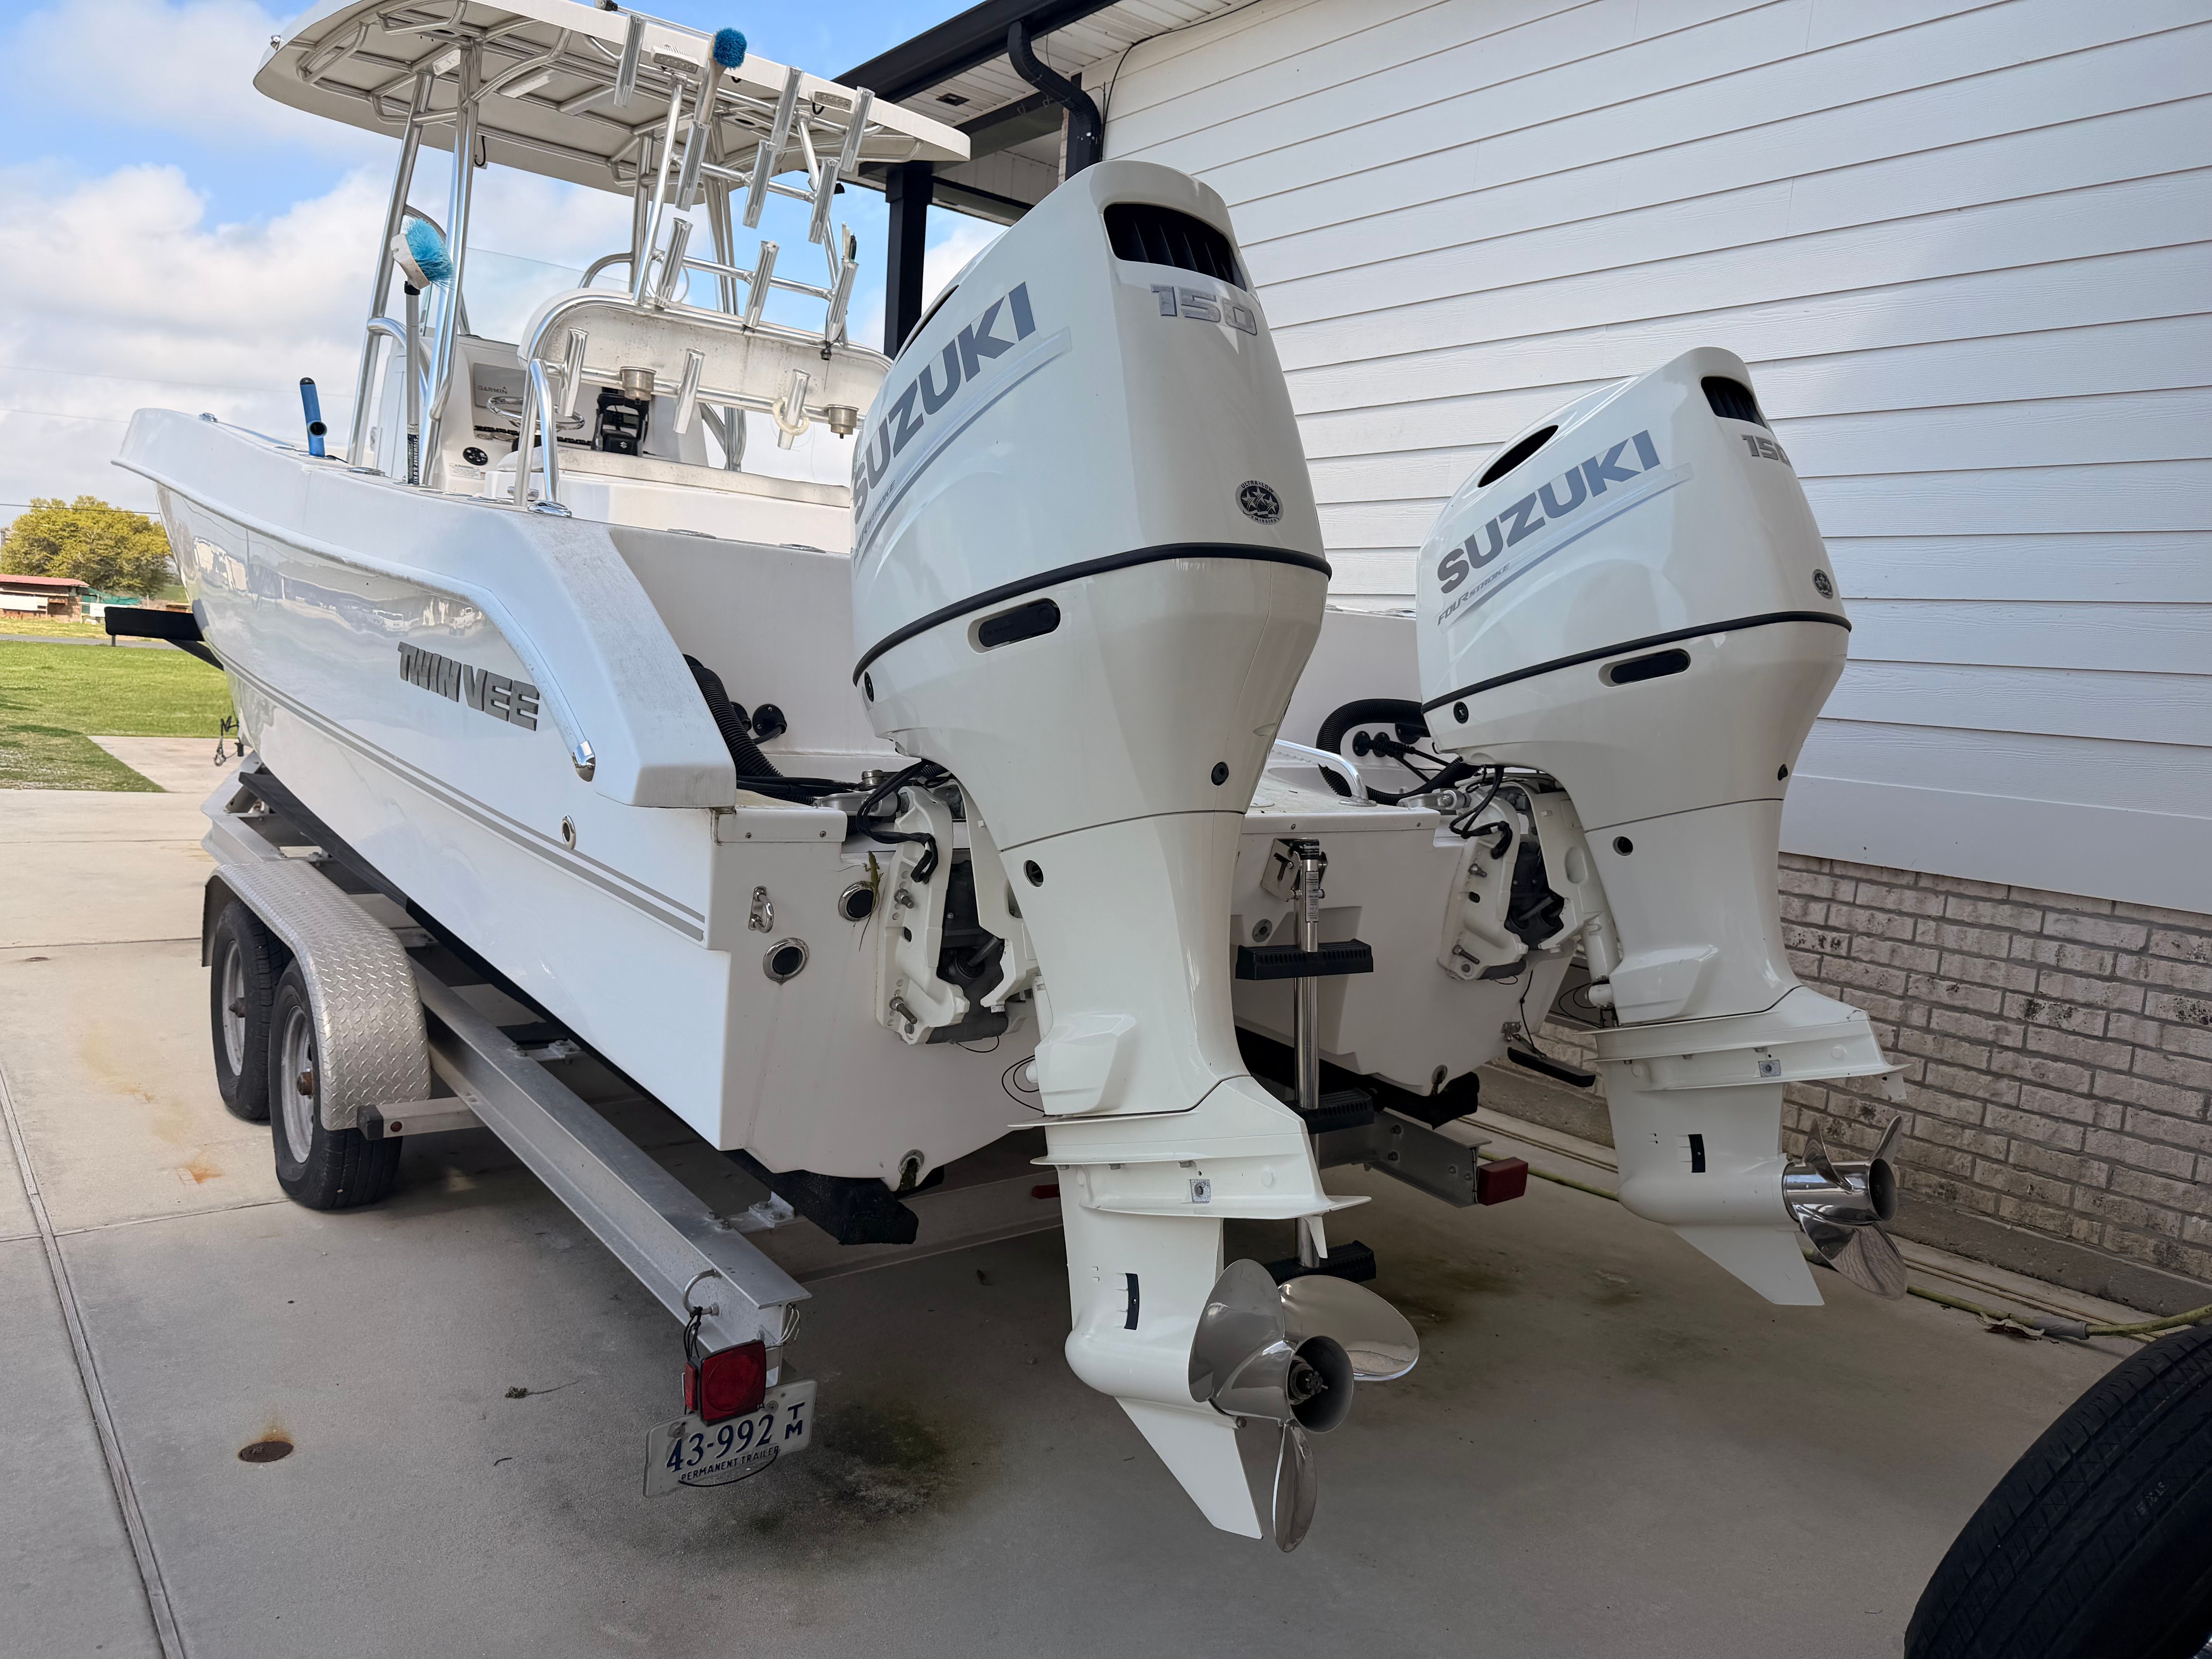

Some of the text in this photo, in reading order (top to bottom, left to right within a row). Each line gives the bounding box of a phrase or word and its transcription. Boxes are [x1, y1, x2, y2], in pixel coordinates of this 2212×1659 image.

[1151, 284, 1257, 336] 150
[478, 385, 507, 394] GARMIN
[853, 281, 1036, 524] SUZUKI
[1261, 483, 1274, 493] LOW
[1437, 429, 1661, 594] SUZUKI
[666, 1414, 775, 1472] 43-992
[681, 1445, 779, 1480] PERMANENT TRAILER
